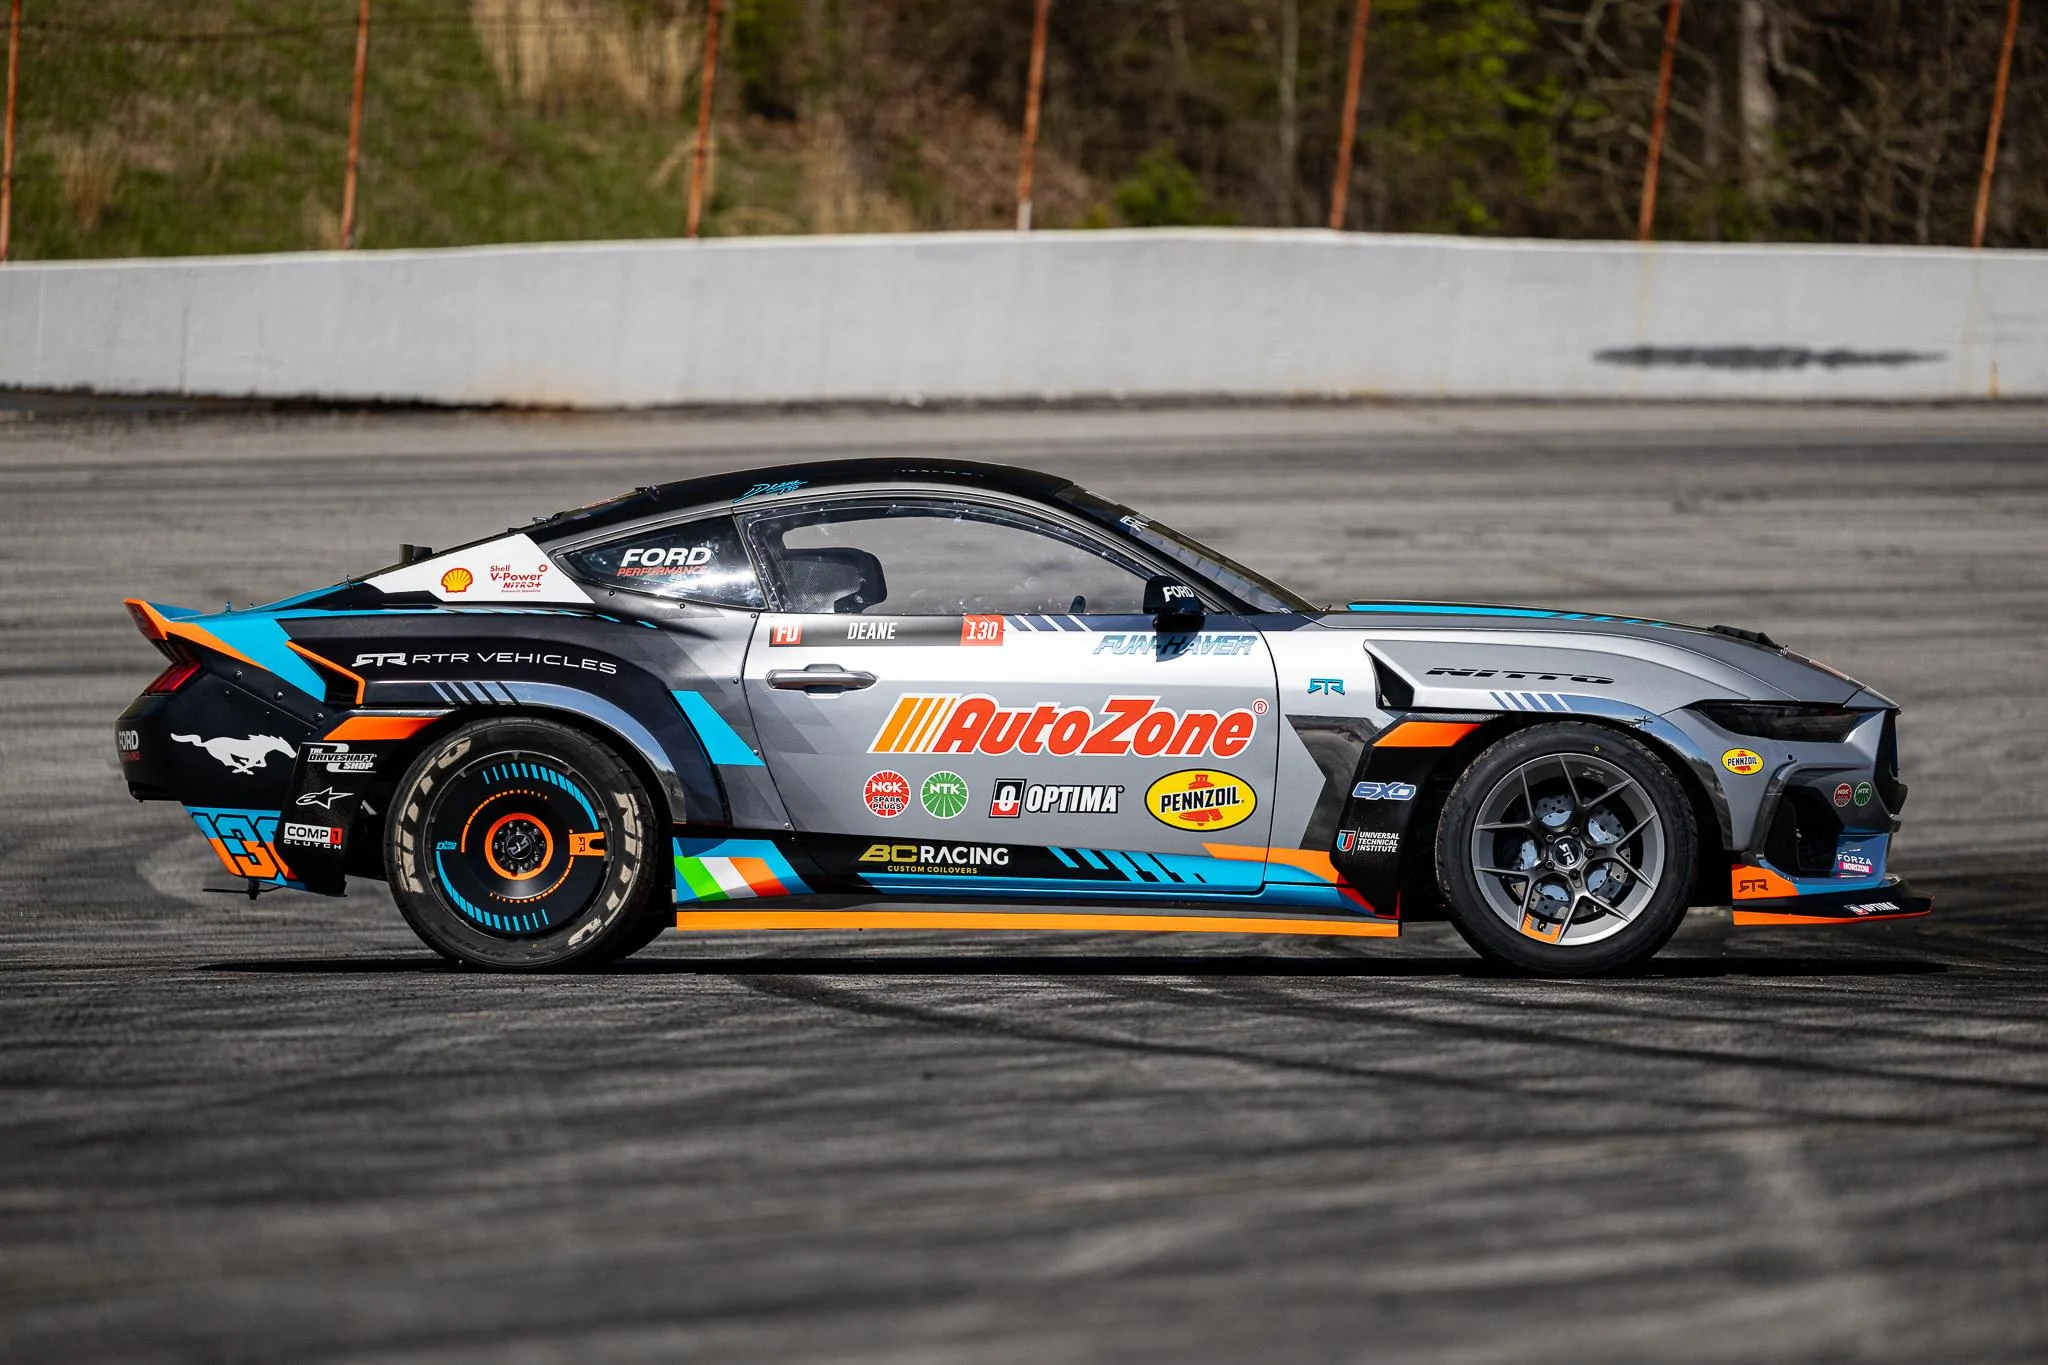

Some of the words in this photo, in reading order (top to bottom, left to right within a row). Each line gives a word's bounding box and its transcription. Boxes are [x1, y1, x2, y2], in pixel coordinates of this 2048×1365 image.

[621, 547, 712, 567] FORD
[489, 564, 511, 572] Shell
[617, 565, 708, 577] PERFORMANCE
[490, 572, 543, 581] V-Power
[1162, 585, 1195, 603] FORD
[847, 622, 897, 640] DEANE
[966, 621, 999, 640] 130
[1093, 634, 1258, 656] FUN-HAVER
[412, 652, 469, 664] RTR
[476, 652, 617, 675] VEHICLES
[1425, 667, 1616, 685] NITTO
[118, 730, 139, 751] FORD
[308, 753, 374, 762] DRIVESHAFT
[343, 762, 374, 770] SHOP
[871, 781, 902, 793] NGK
[929, 782, 960, 795] NTK
[1026, 784, 1119, 813] OPTIMA
[1160, 786, 1240, 812] PENNZOIL
[287, 826, 329, 839] COMP
[1359, 832, 1400, 840] UNIVERSAL
[284, 839, 341, 850] CLUTCH
[1358, 838, 1398, 846] TECHNICAL
[920, 845, 1010, 866] RACING
[1357, 845, 1397, 853] INSTITUTE
[1837, 854, 1873, 866] FORZA
[887, 865, 925, 873] CUSTOM
[927, 866, 978, 874] COILOVERS
